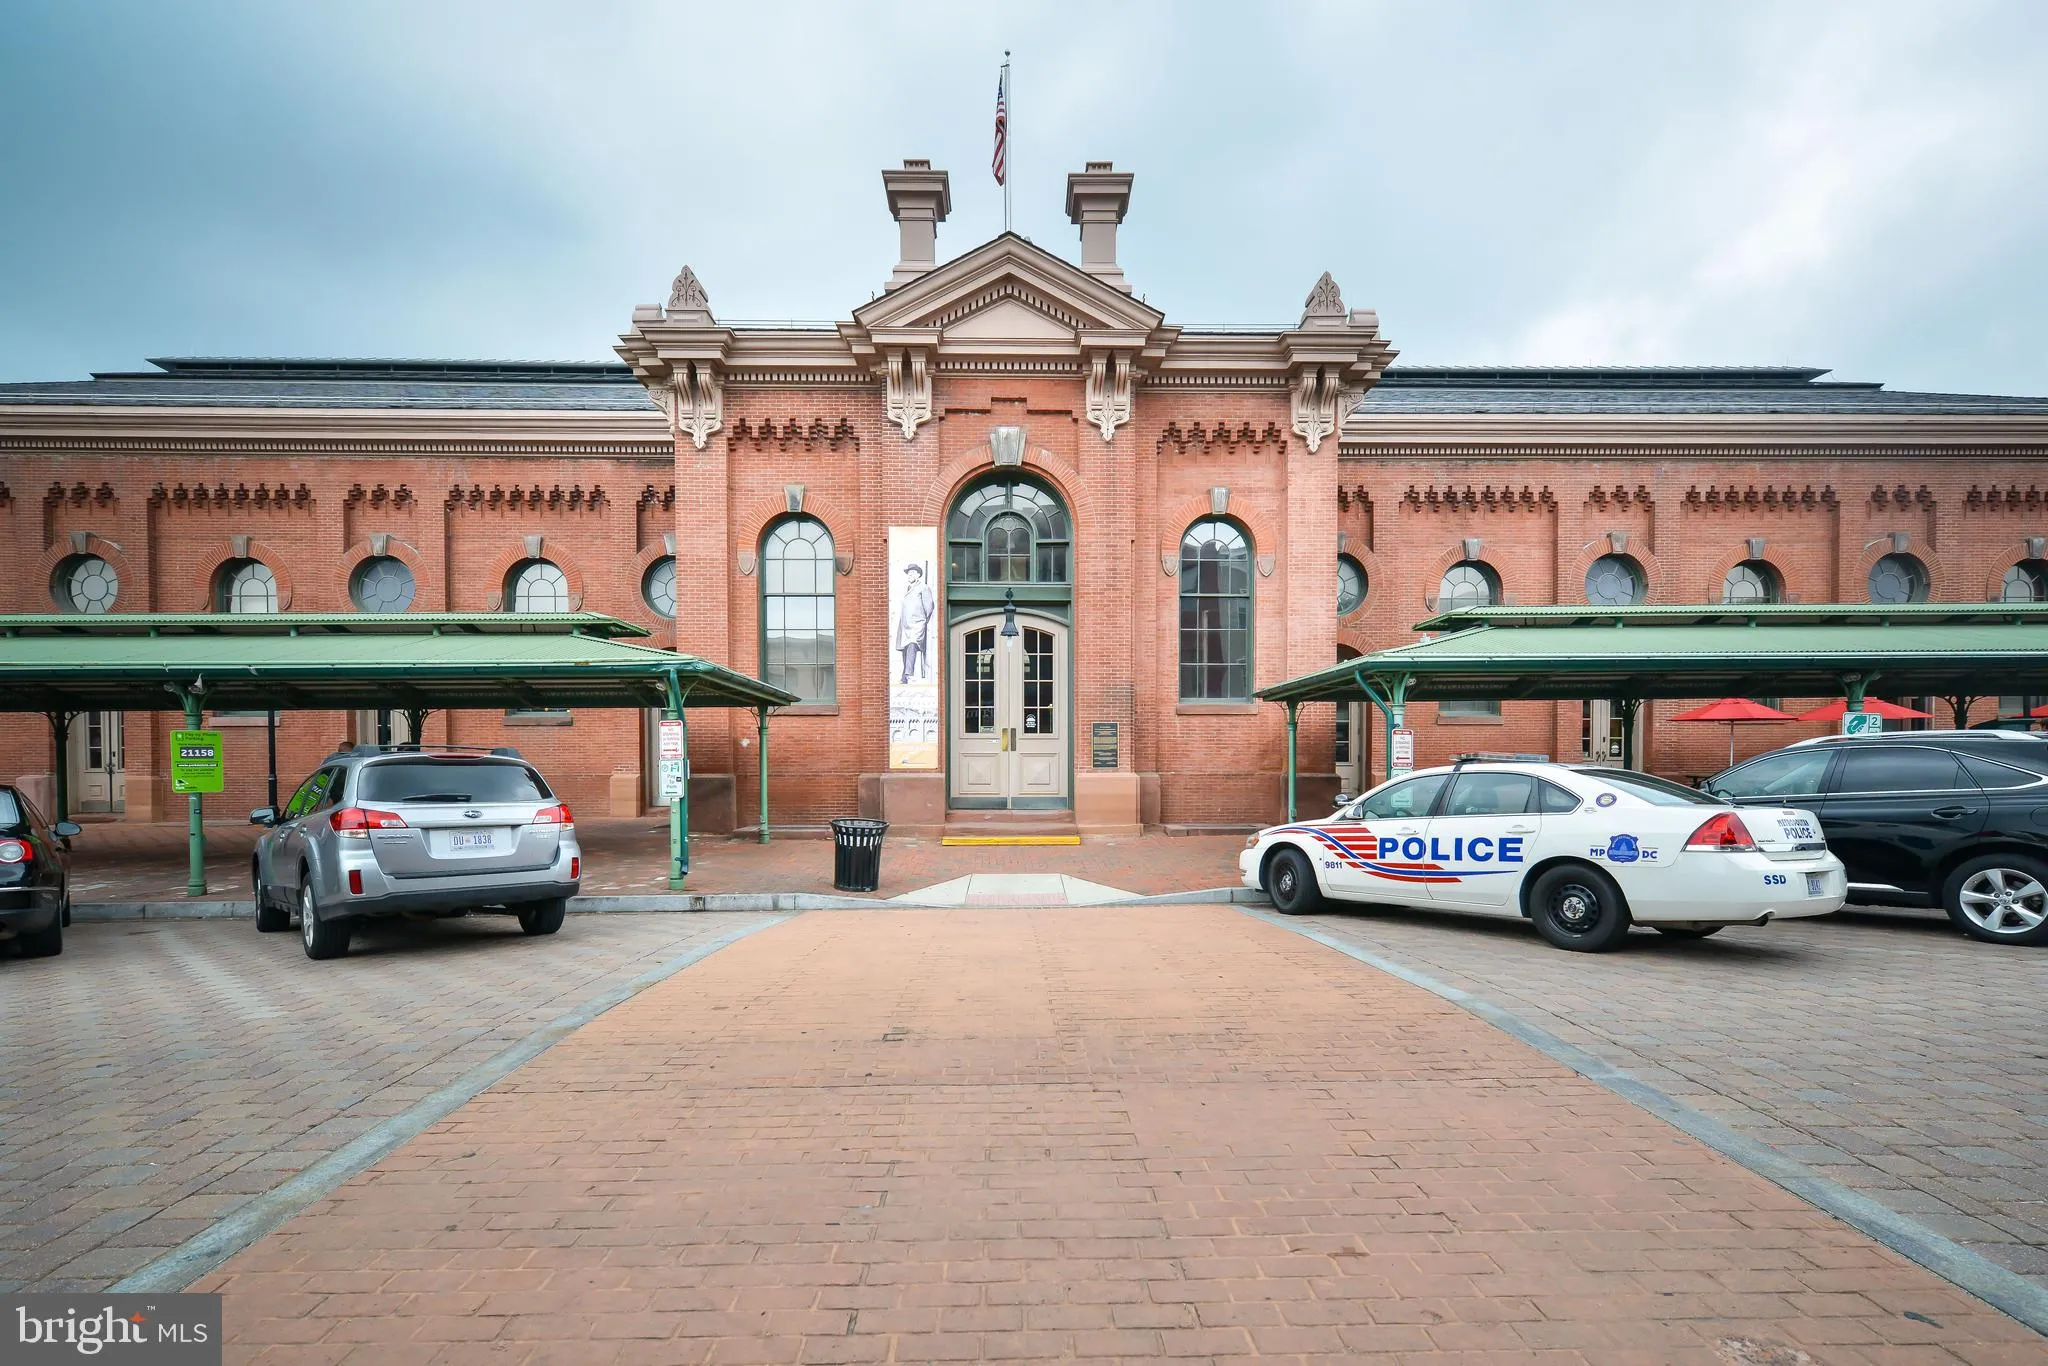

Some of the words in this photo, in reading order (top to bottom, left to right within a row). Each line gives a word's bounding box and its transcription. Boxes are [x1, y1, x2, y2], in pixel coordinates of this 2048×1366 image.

[1871, 717, 1878, 725] 2
[181, 749, 214, 757] 21158
[1783, 827, 1813, 839] POLICE
[453, 836, 464, 846] DU
[473, 834, 492, 845] 1838
[1379, 837, 1524, 862] POLICE
[1589, 848, 1606, 857] MP
[1642, 850, 1658, 859] DC
[1324, 861, 1343, 869] 9811
[1763, 874, 1787, 885] SSD
